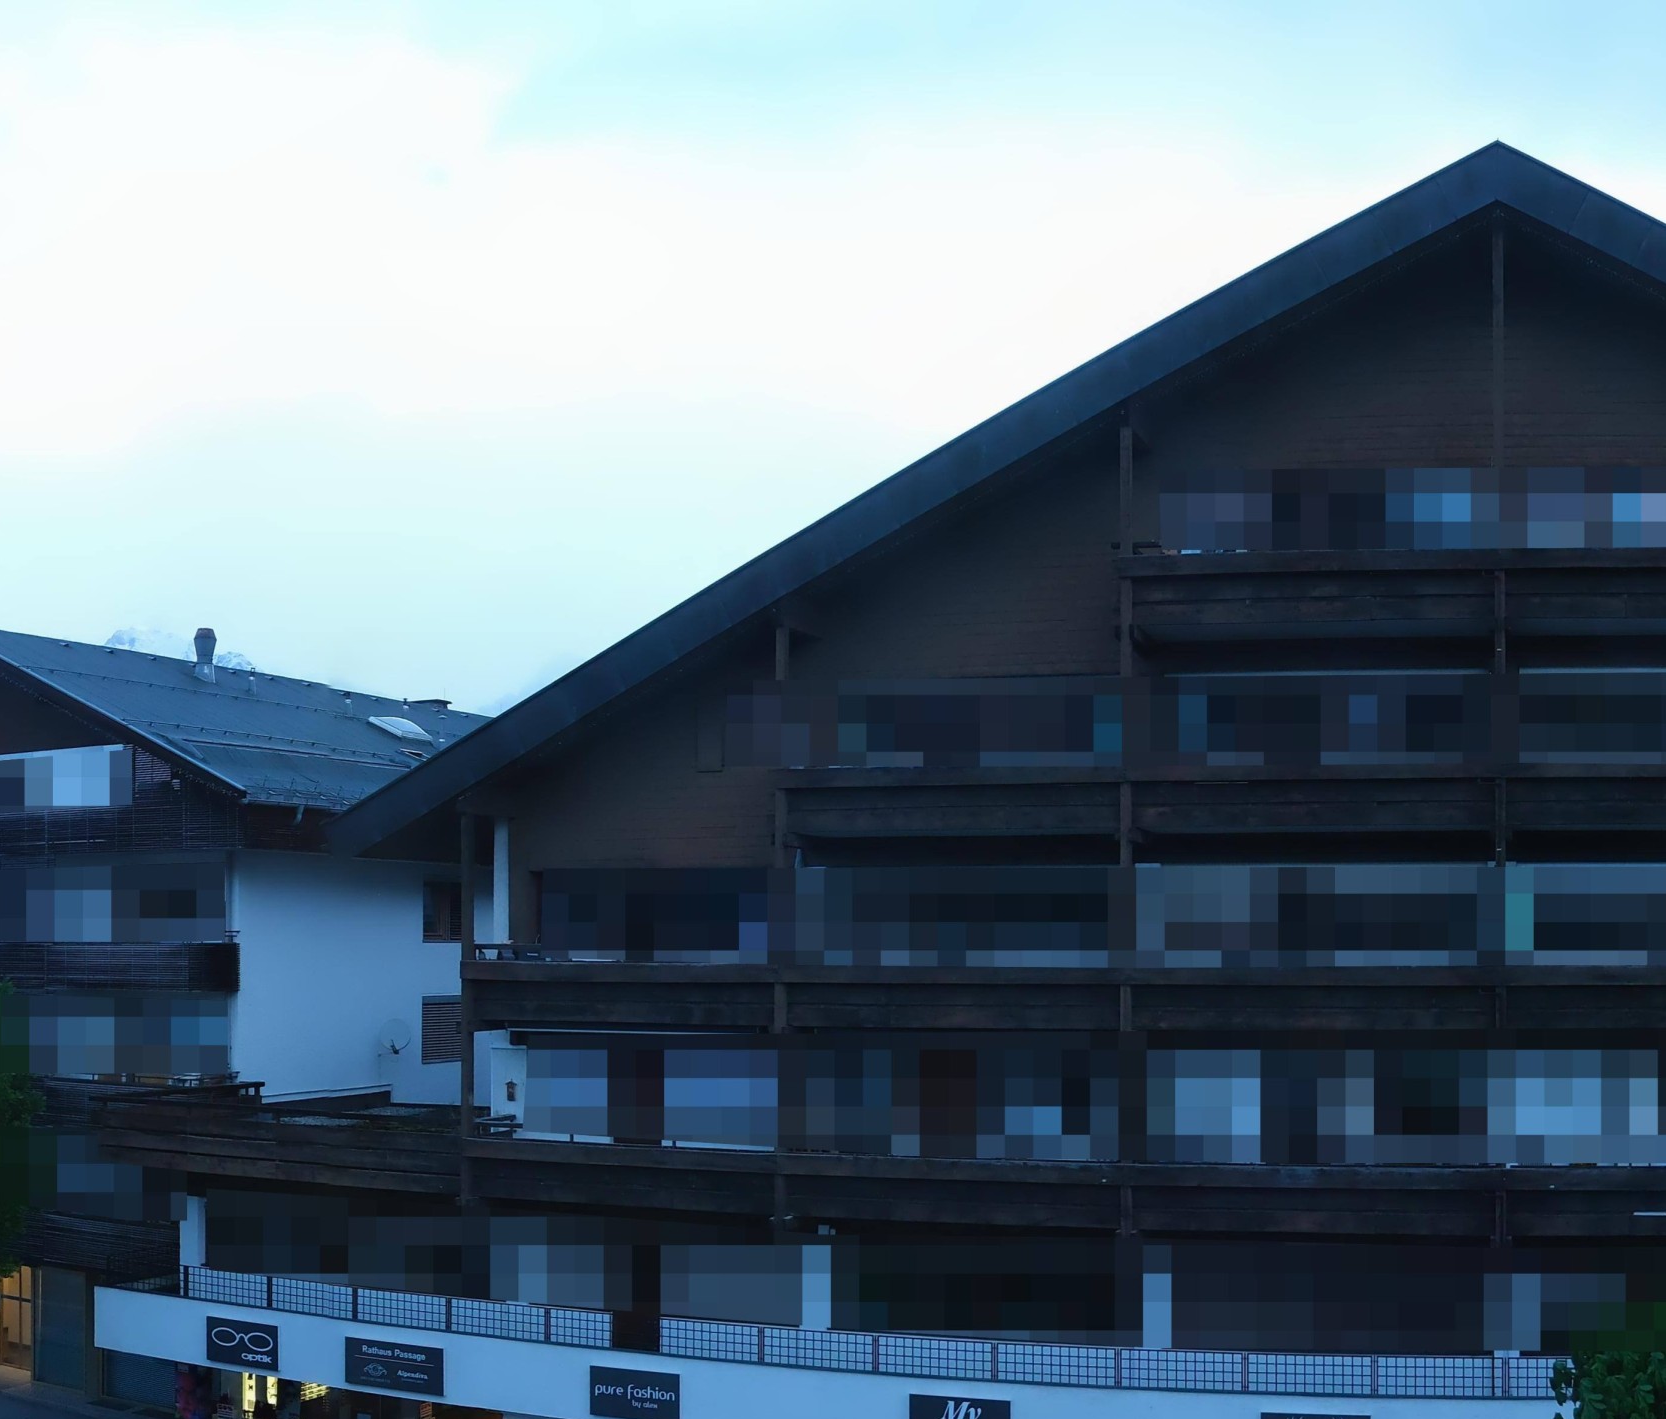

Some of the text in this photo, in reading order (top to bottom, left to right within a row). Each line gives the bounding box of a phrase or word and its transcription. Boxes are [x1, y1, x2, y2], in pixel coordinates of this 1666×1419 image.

[241, 1352, 272, 1364] optik
[362, 1345, 426, 1361] Rathaus Passage
[594, 1384, 675, 1401] pure fashion
[632, 1400, 641, 1409] by
